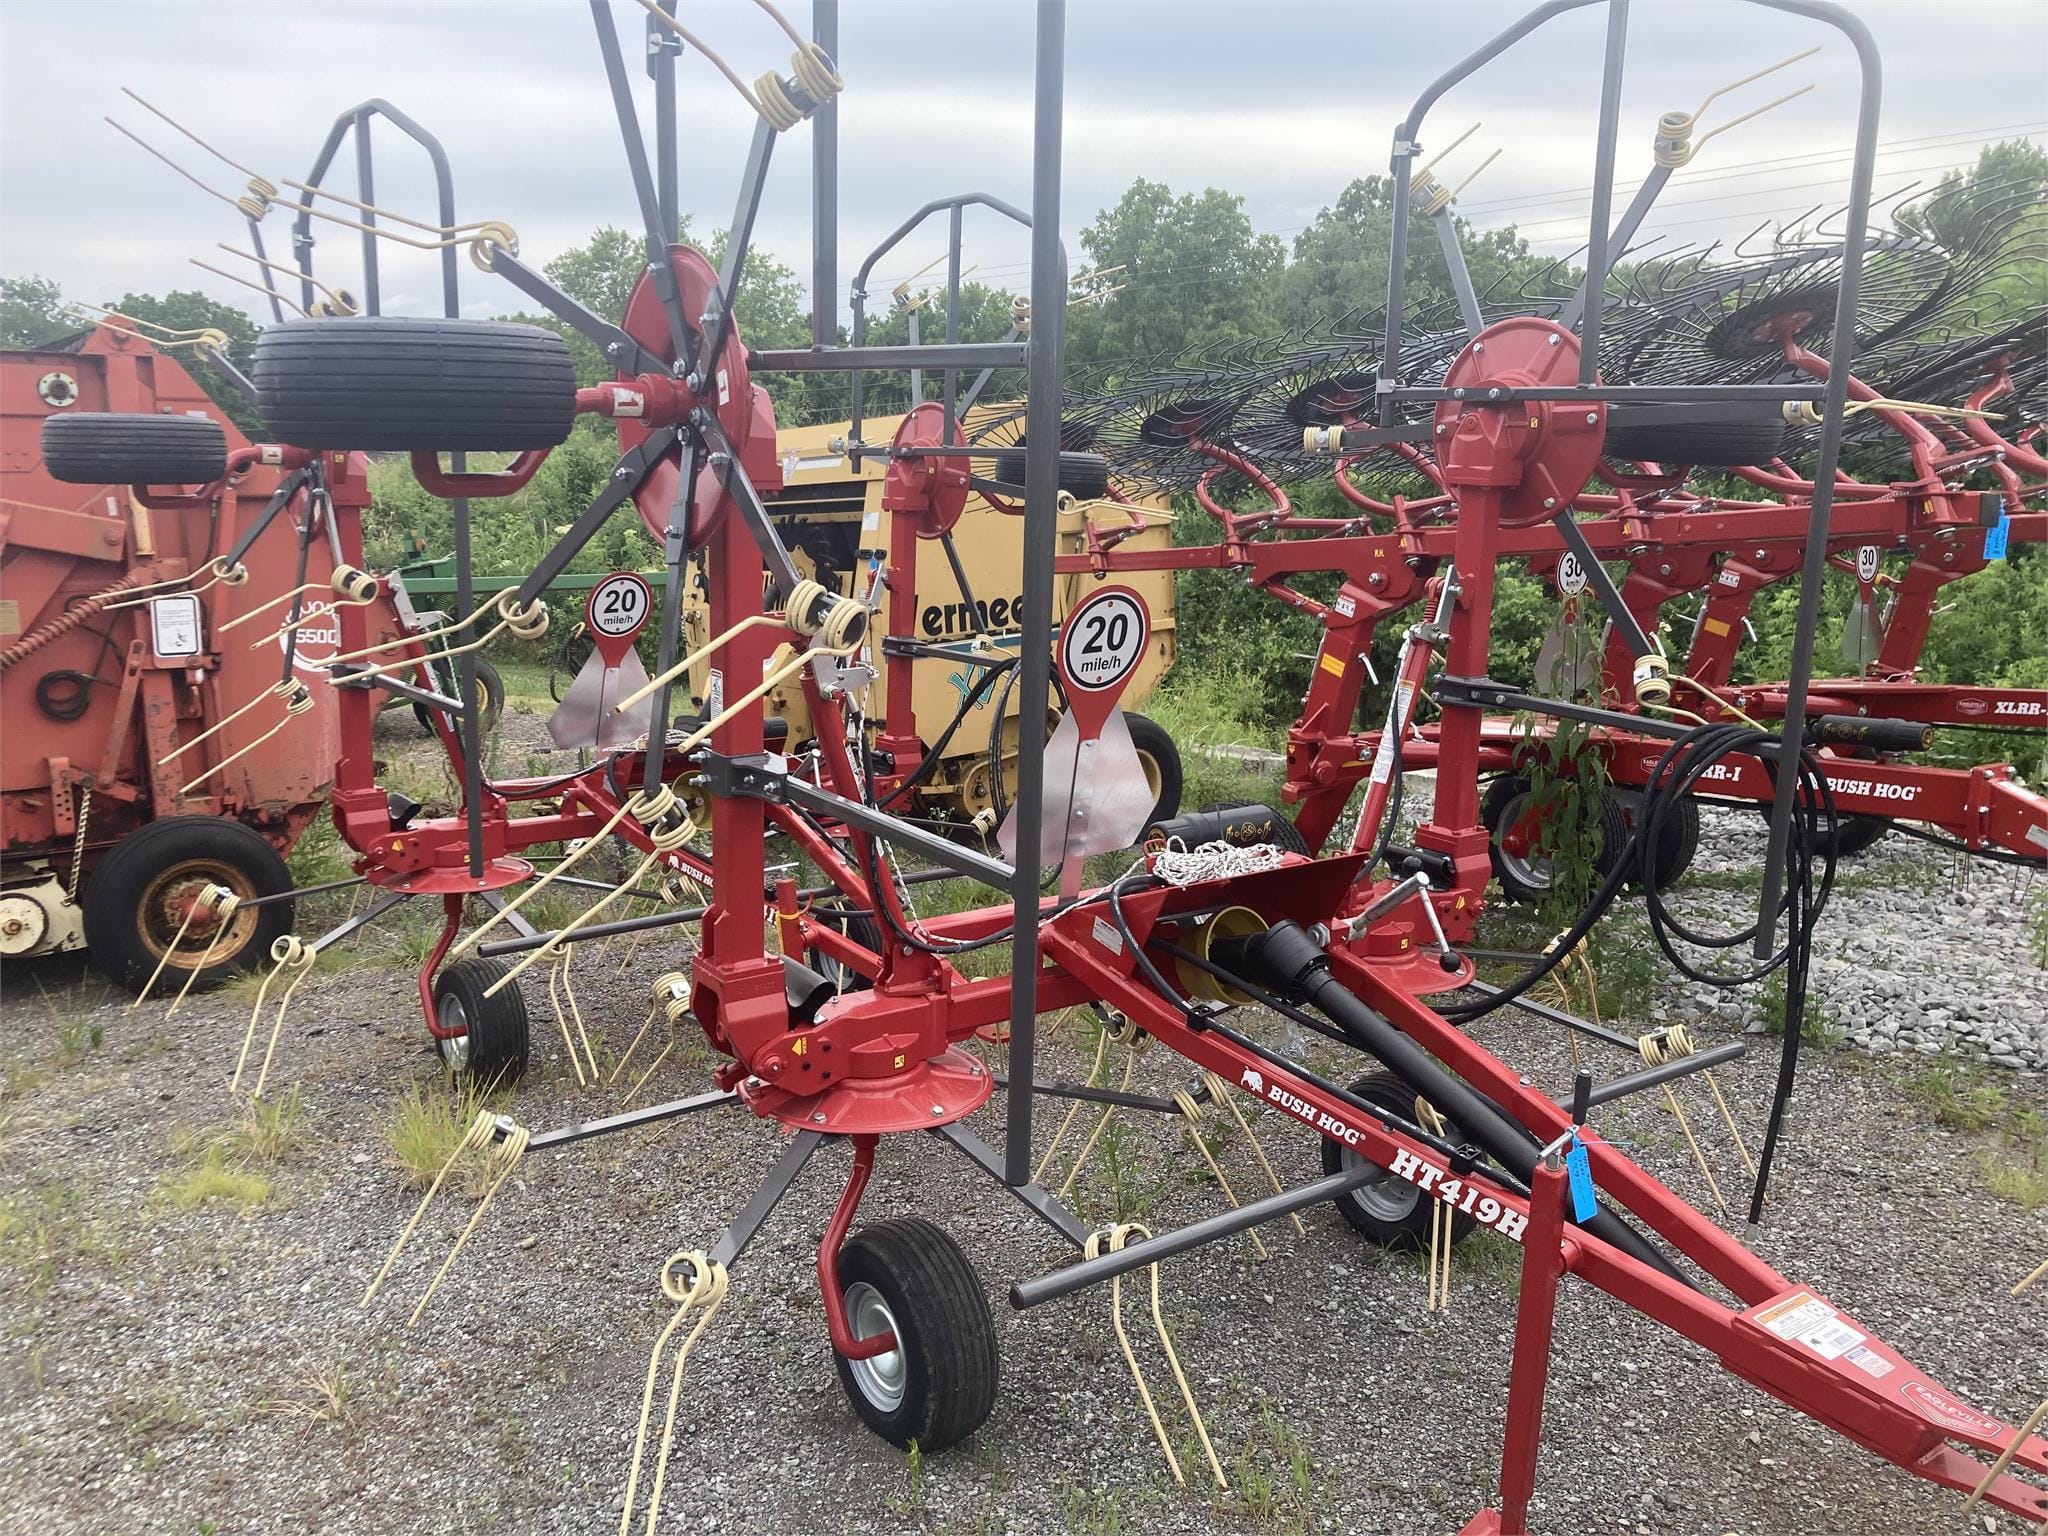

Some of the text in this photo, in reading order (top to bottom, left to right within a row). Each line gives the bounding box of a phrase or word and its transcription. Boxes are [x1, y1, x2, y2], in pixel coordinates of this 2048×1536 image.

[1565, 558, 1582, 577] 30
[1863, 550, 1874, 566] 30
[603, 589, 636, 614] 20
[603, 615, 633, 625] mile/h
[914, 595, 1023, 637] ermee
[1081, 613, 1128, 654] 20
[1081, 655, 1121, 673] mile/h
[1826, 777, 1873, 796] BUSH
[681, 862, 702, 881] BUSH
[1267, 1085, 1318, 1121] BUSH
[1389, 1147, 1529, 1242] HT419H
[1915, 1386, 1994, 1430] EAGLEVILLE
